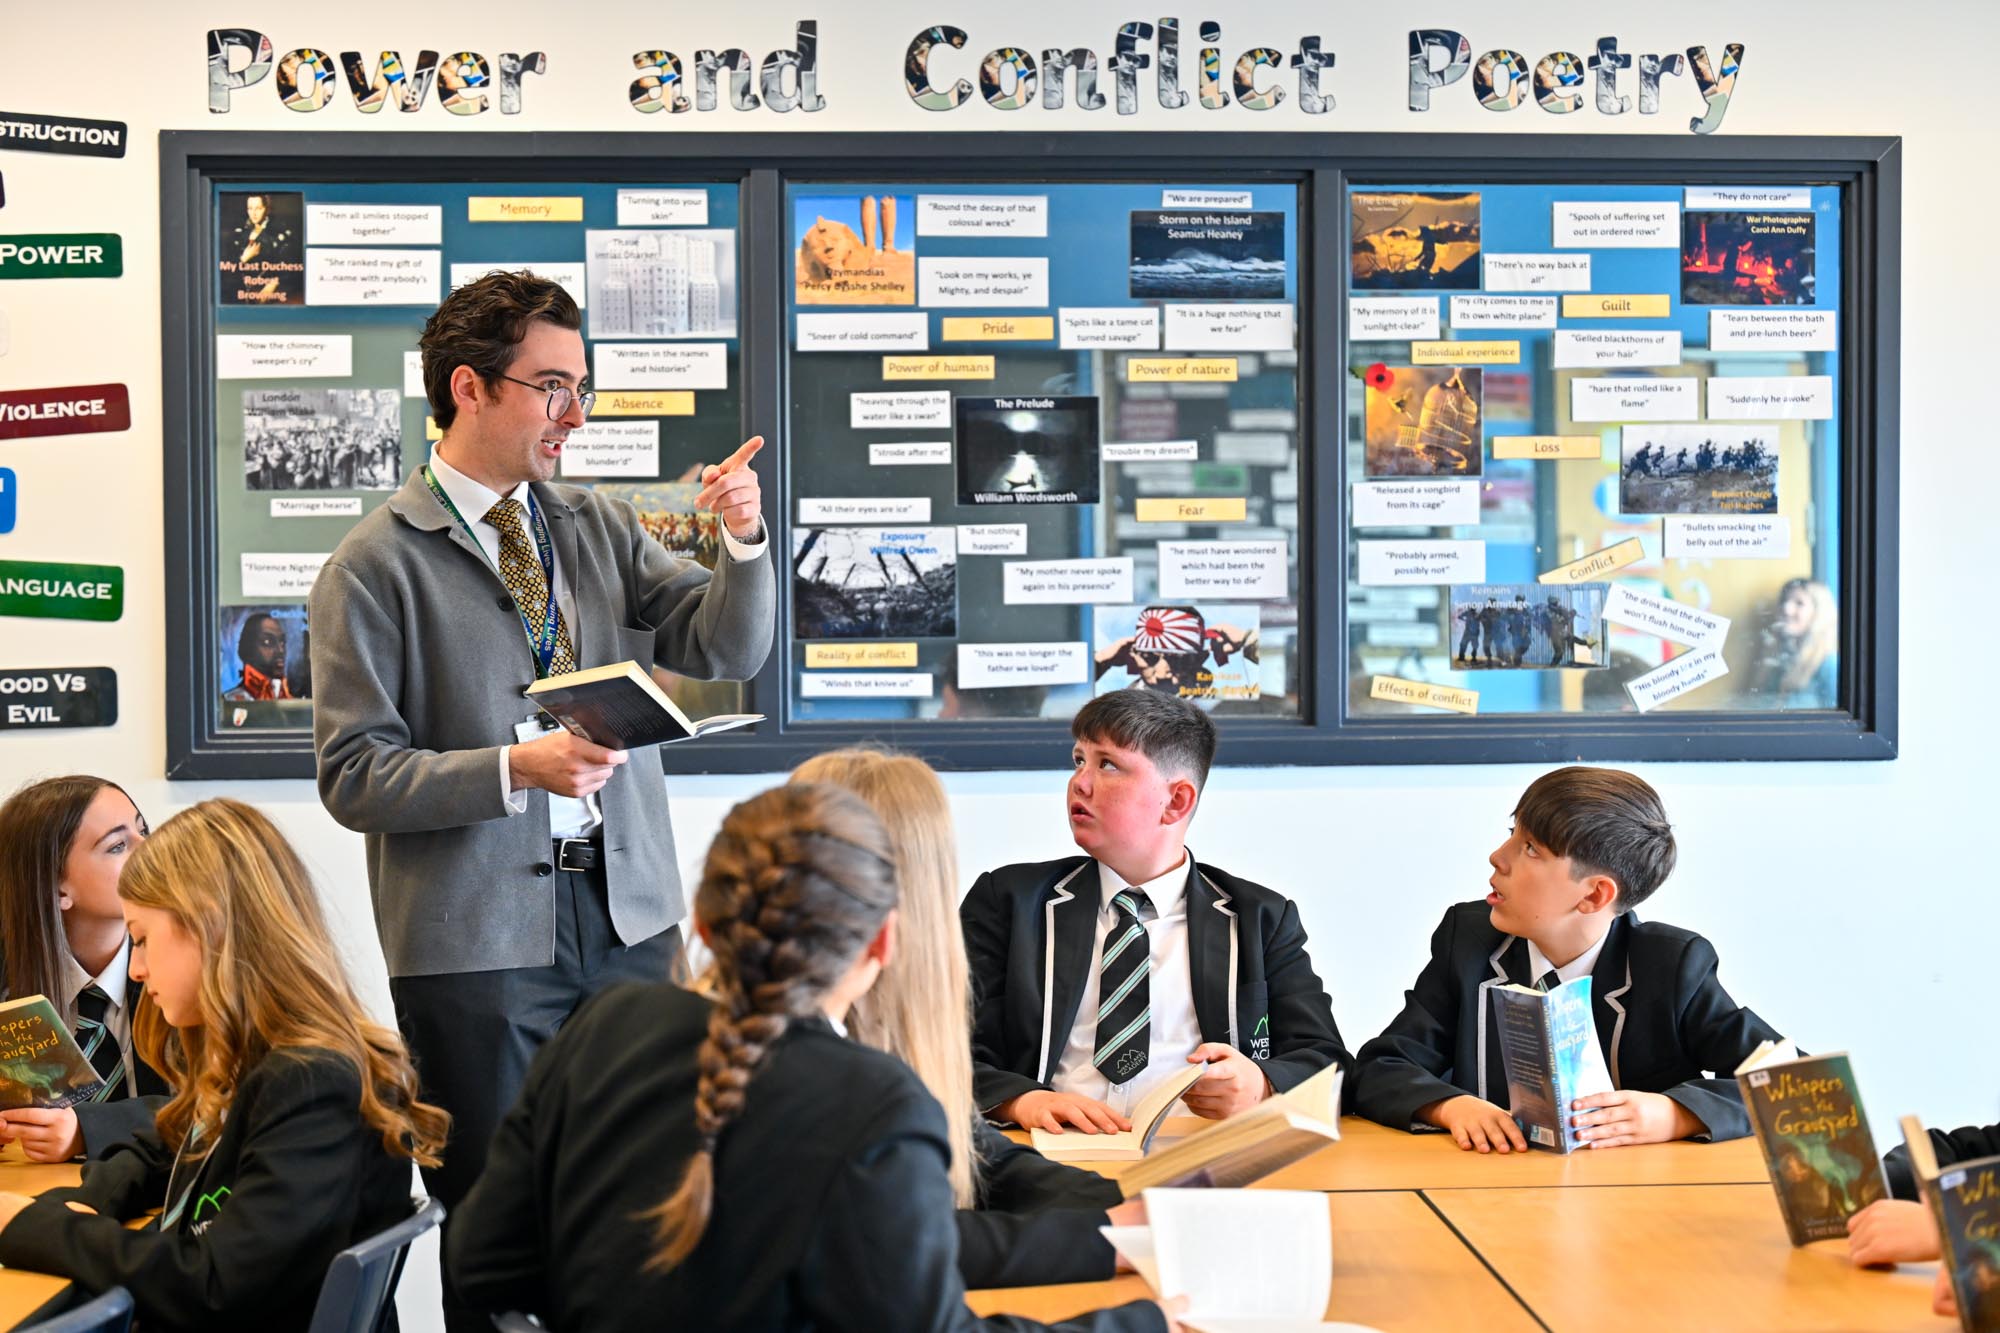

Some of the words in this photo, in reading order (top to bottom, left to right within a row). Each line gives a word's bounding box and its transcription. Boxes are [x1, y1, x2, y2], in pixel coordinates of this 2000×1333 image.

[208, 27, 547, 116] Power
[629, 19, 826, 114] and
[904, 17, 1336, 116] Conflict
[1407, 27, 1746, 135] Poetry
[1167, 193, 1187, 202] "We
[1188, 195, 1203, 203] are
[1204, 194, 1248, 204] prepared"
[1712, 191, 1738, 202] "They
[1739, 191, 1751, 201] do
[1752, 193, 1768, 201] not
[1768, 192, 1792, 201] care"
[500, 203, 552, 217] Memory
[928, 202, 961, 211] "Round
[962, 203, 978, 212] the
[979, 204, 1005, 213] decay
[1006, 203, 1017, 212] of
[1018, 204, 1036, 213] that
[320, 210, 347, 220] "Then
[349, 211, 360, 220] all
[362, 212, 390, 220] smiles
[392, 212, 429, 221] stopped
[1158, 214, 1189, 225] Storm
[1190, 216, 1204, 225] on
[1204, 214, 1222, 225] the
[1223, 215, 1252, 225] Island
[1569, 212, 1601, 222] "Spools
[1602, 212, 1612, 221] of
[1614, 212, 1651, 222] suffering
[1652, 213, 1665, 221] set
[1746, 215, 1762, 224] War
[1762, 215, 1811, 225] Photographer
[948, 218, 983, 227] colossal
[985, 218, 1015, 227] wreck"
[352, 226, 396, 237] together"
[1167, 227, 1206, 240] Seamus
[1207, 227, 1244, 241] Heaney
[1573, 228, 1588, 236] out
[1589, 227, 1598, 236] in
[1599, 227, 1634, 236] ordered
[1635, 227, 1660, 236] rows"
[1750, 225, 1770, 234] Carol
[1770, 225, 1786, 234] Ann
[1786, 225, 1807, 235] Duffy
[0, 243, 104, 265] POWER
[218, 259, 237, 272] My
[238, 259, 260, 271] Last
[261, 259, 305, 272] Duchess
[243, 274, 280, 286] Robert
[935, 271, 960, 279] "Look
[975, 272, 989, 280] my
[991, 271, 1020, 280] works,
[1022, 272, 1033, 281] ye
[237, 289, 287, 302] Browning
[938, 286, 971, 296] Mighty,
[973, 286, 990, 295] and
[991, 286, 1029, 296] despair"
[1601, 299, 1631, 311] Guilt
[1176, 309, 1187, 318] "It
[1205, 309, 1227, 320] huge
[1228, 310, 1262, 320] nothing
[1263, 310, 1281, 319] that
[1722, 314, 1749, 322] "Tears
[1750, 314, 1788, 322] between
[1789, 314, 1804, 323] the
[1805, 314, 1825, 323] bath
[982, 321, 1015, 334] Pride
[1225, 324, 1247, 333] fear"
[1730, 328, 1746, 337] and
[1747, 329, 1788, 339] pre-lunch
[1789, 329, 1817, 338] beers"
[612, 349, 650, 358] "Written
[662, 349, 678, 358] the
[1417, 347, 1464, 357] Individual
[1466, 347, 1515, 358] experience
[629, 365, 647, 373] and
[648, 364, 691, 373] histories"
[888, 362, 925, 373] Power
[928, 360, 940, 373] of
[943, 361, 990, 373] humans
[1136, 364, 1172, 375] Power
[1176, 362, 1188, 375] of
[1192, 365, 1230, 375] nature
[1588, 384, 1612, 393] "hare
[1613, 384, 1631, 393] that
[1633, 384, 1658, 393] rolled
[1659, 384, 1675, 392] like
[262, 392, 301, 403] London
[612, 396, 664, 409] Absence
[994, 398, 1014, 409] The
[1015, 398, 1055, 408] Prelude
[1621, 399, 1649, 408] flame"
[1534, 441, 1560, 453] Loss
[974, 491, 1014, 503] William
[1015, 491, 1078, 503] Wordsworth
[276, 501, 321, 511] "Marriage
[322, 501, 357, 509] hearse"
[1178, 504, 1205, 516] Fear
[880, 531, 926, 543] Exposure
[1170, 547, 1185, 555] "he
[1187, 547, 1208, 555] must
[1210, 547, 1231, 555] have
[1233, 546, 1277, 555] wondered
[1181, 562, 1207, 570] which
[1208, 561, 1225, 570] had
[1227, 561, 1249, 570] been
[1250, 561, 1265, 570] the
[1568, 554, 1616, 580] Conflict
[1184, 577, 1211, 585] better
[1212, 578, 1231, 586] way
[1232, 577, 1242, 585] to
[1243, 575, 1261, 585] die"
[816, 650, 852, 661] Reality
[854, 648, 866, 660] of
[867, 648, 907, 660] conflict
[1378, 681, 1415, 698] Effects
[1418, 687, 1430, 699] of
[1432, 689, 1472, 707] conflict
[8, 704, 61, 723] EVIL
[1763, 1072, 1844, 1103] Whispers
[1775, 1103, 1858, 1140] Graveyard
